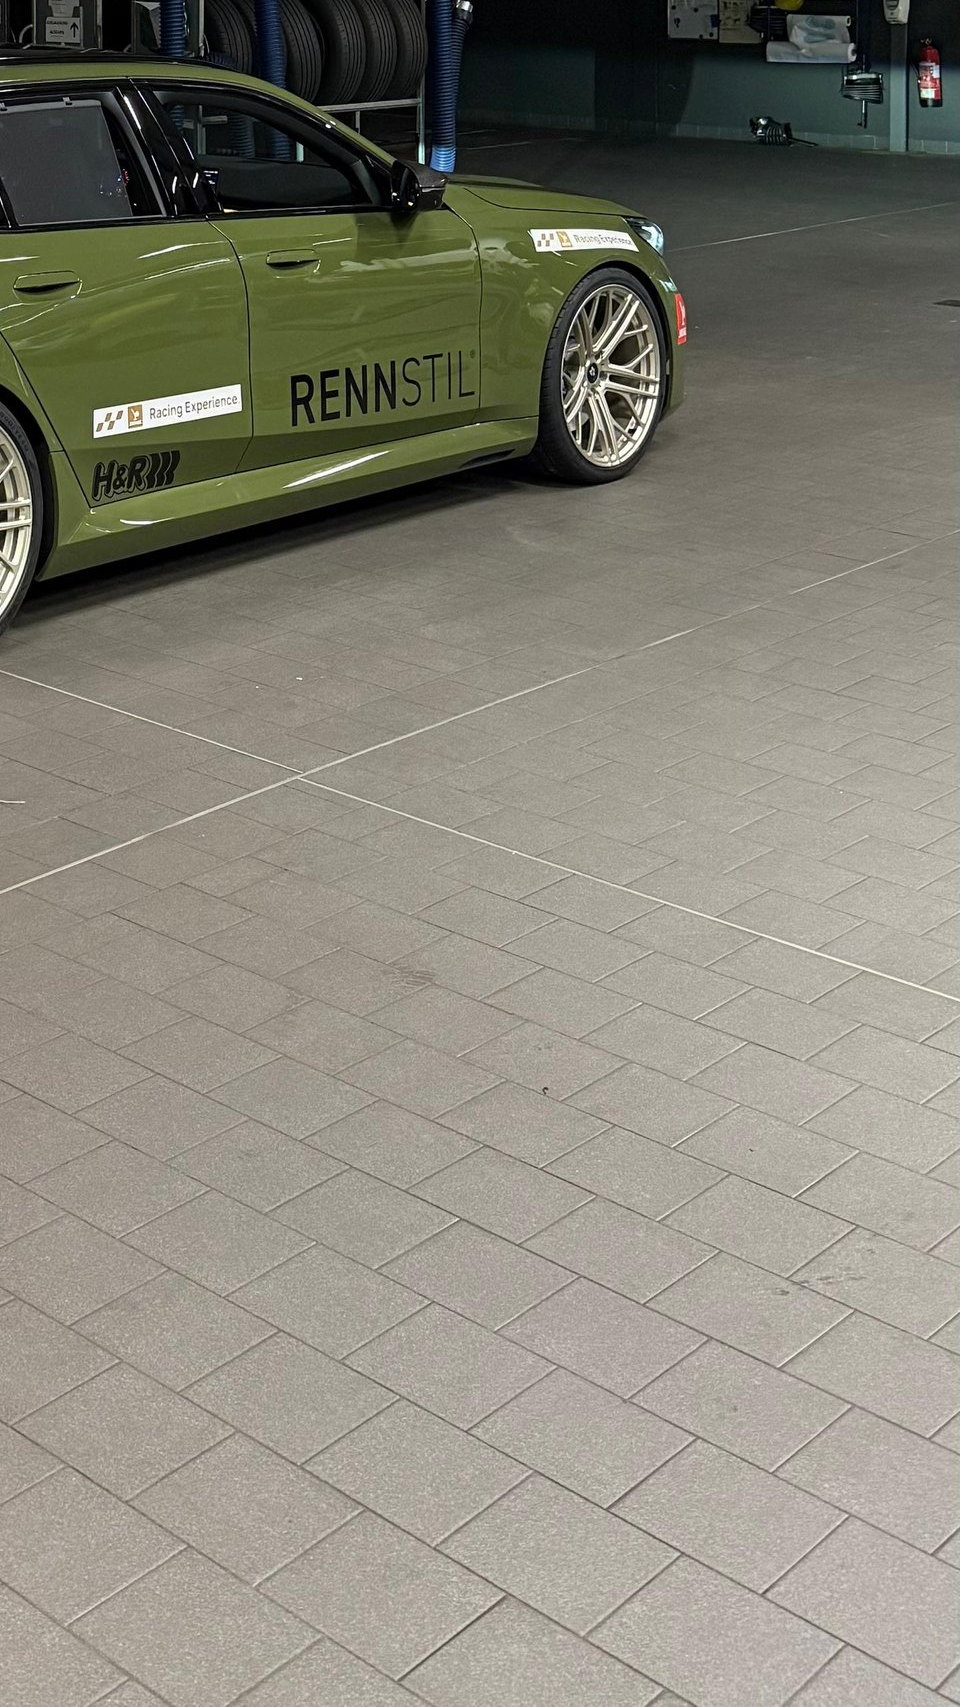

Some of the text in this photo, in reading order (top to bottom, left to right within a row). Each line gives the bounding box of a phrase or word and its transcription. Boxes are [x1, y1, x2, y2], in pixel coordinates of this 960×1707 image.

[573, 234, 599, 244] Racing
[149, 404, 183, 420] Racing
[92, 454, 150, 502] H&R
